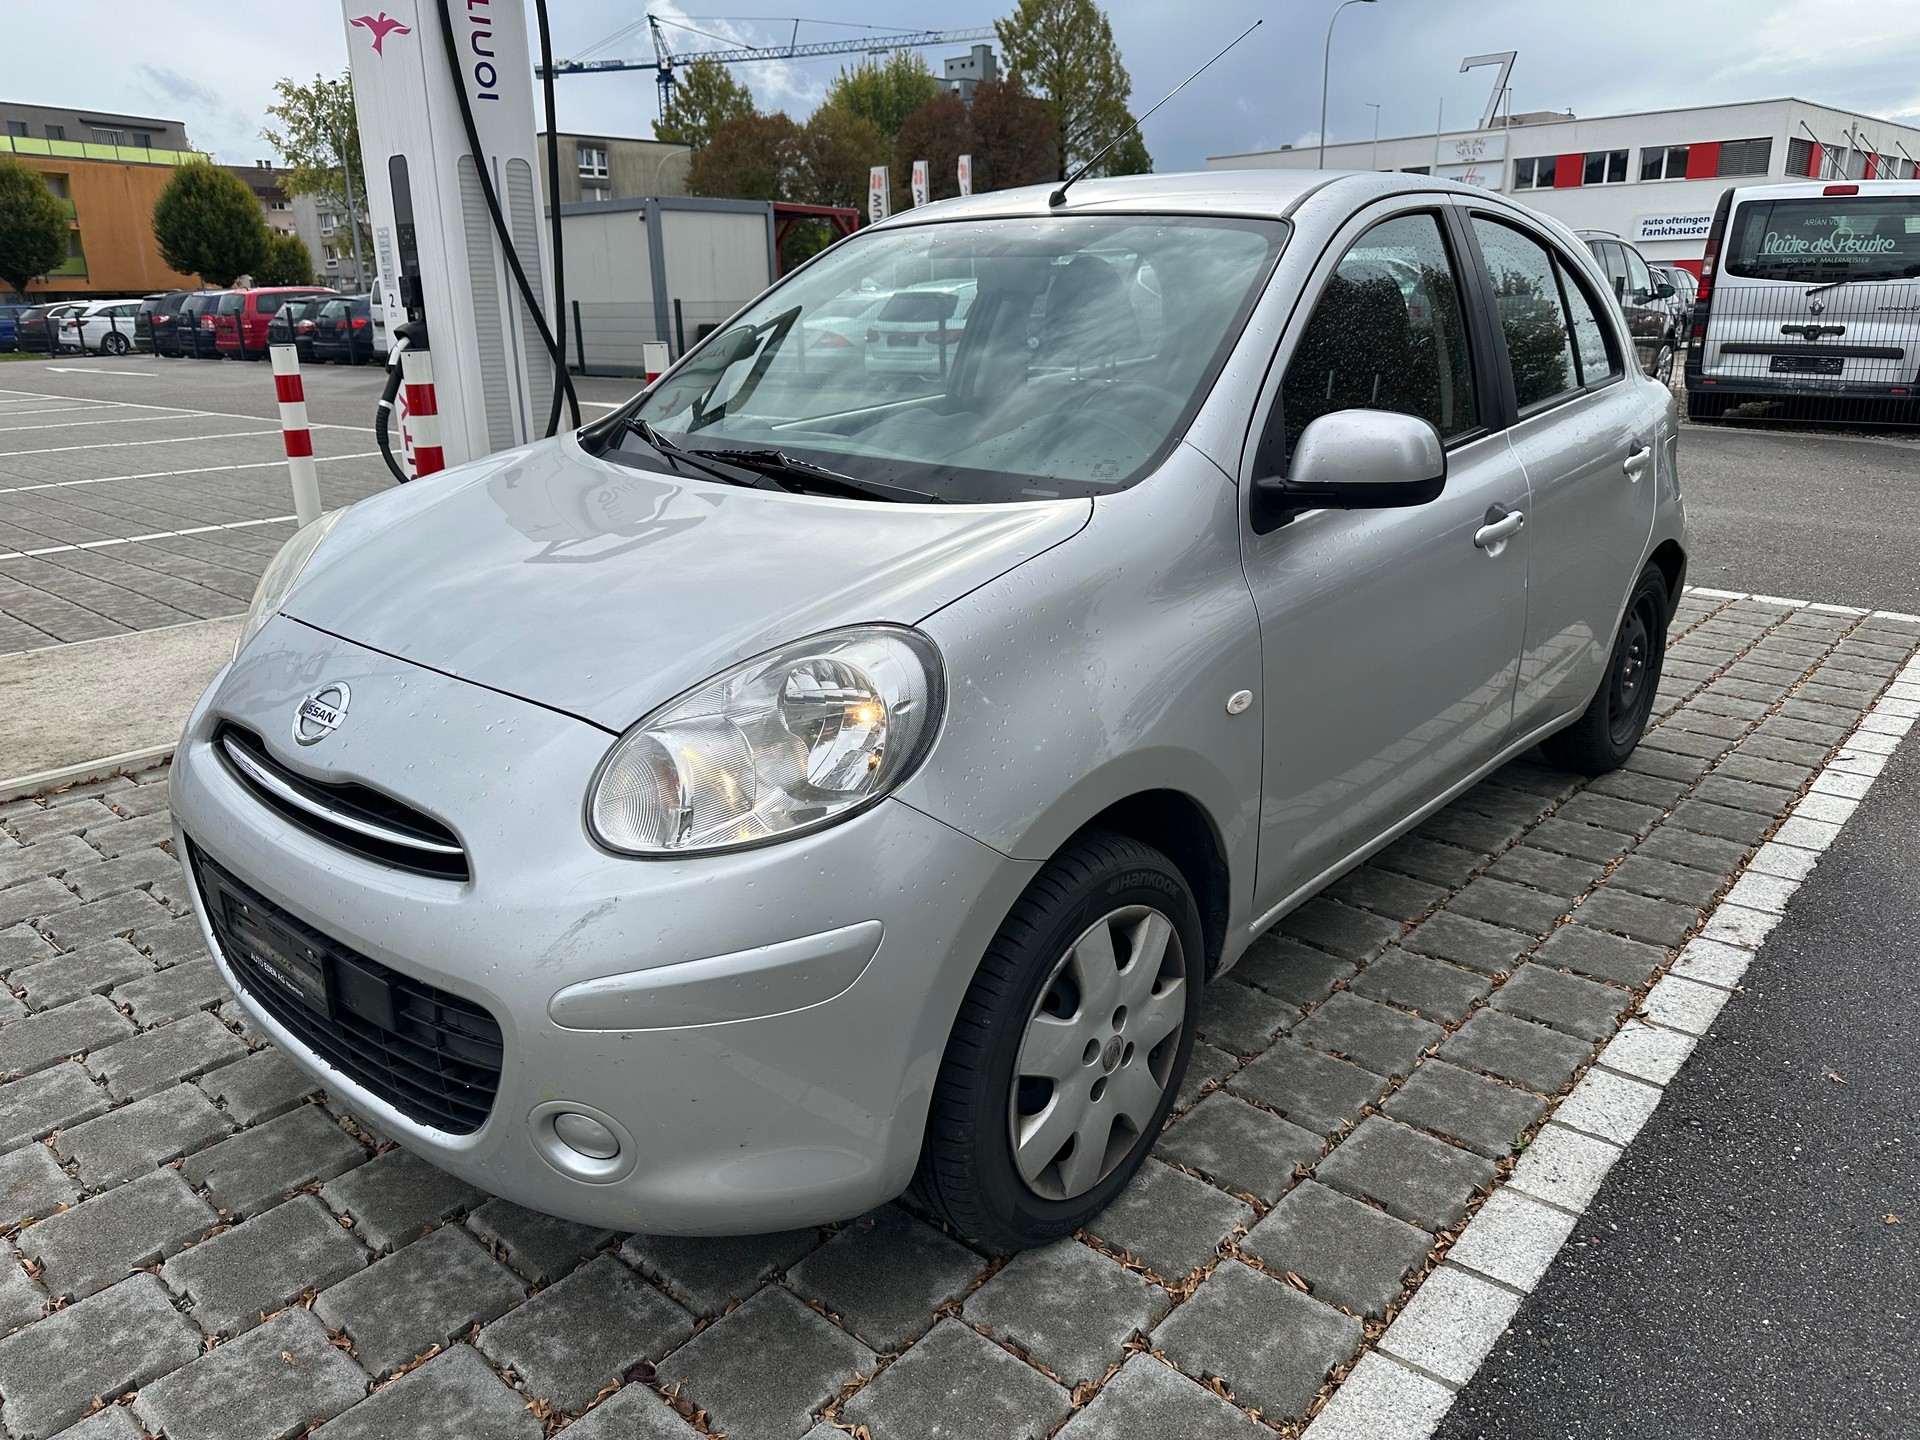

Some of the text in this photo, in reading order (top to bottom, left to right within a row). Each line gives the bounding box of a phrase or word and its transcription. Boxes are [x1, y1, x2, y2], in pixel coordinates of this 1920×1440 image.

[1455, 147, 1483, 157] SEVEN
[1642, 216, 1711, 226] auto oftringen
[1803, 218, 1827, 226] ARIAN
[1641, 226, 1709, 237] fankhauser
[1810, 237, 1832, 254] de
[388, 293, 396, 308] 2
